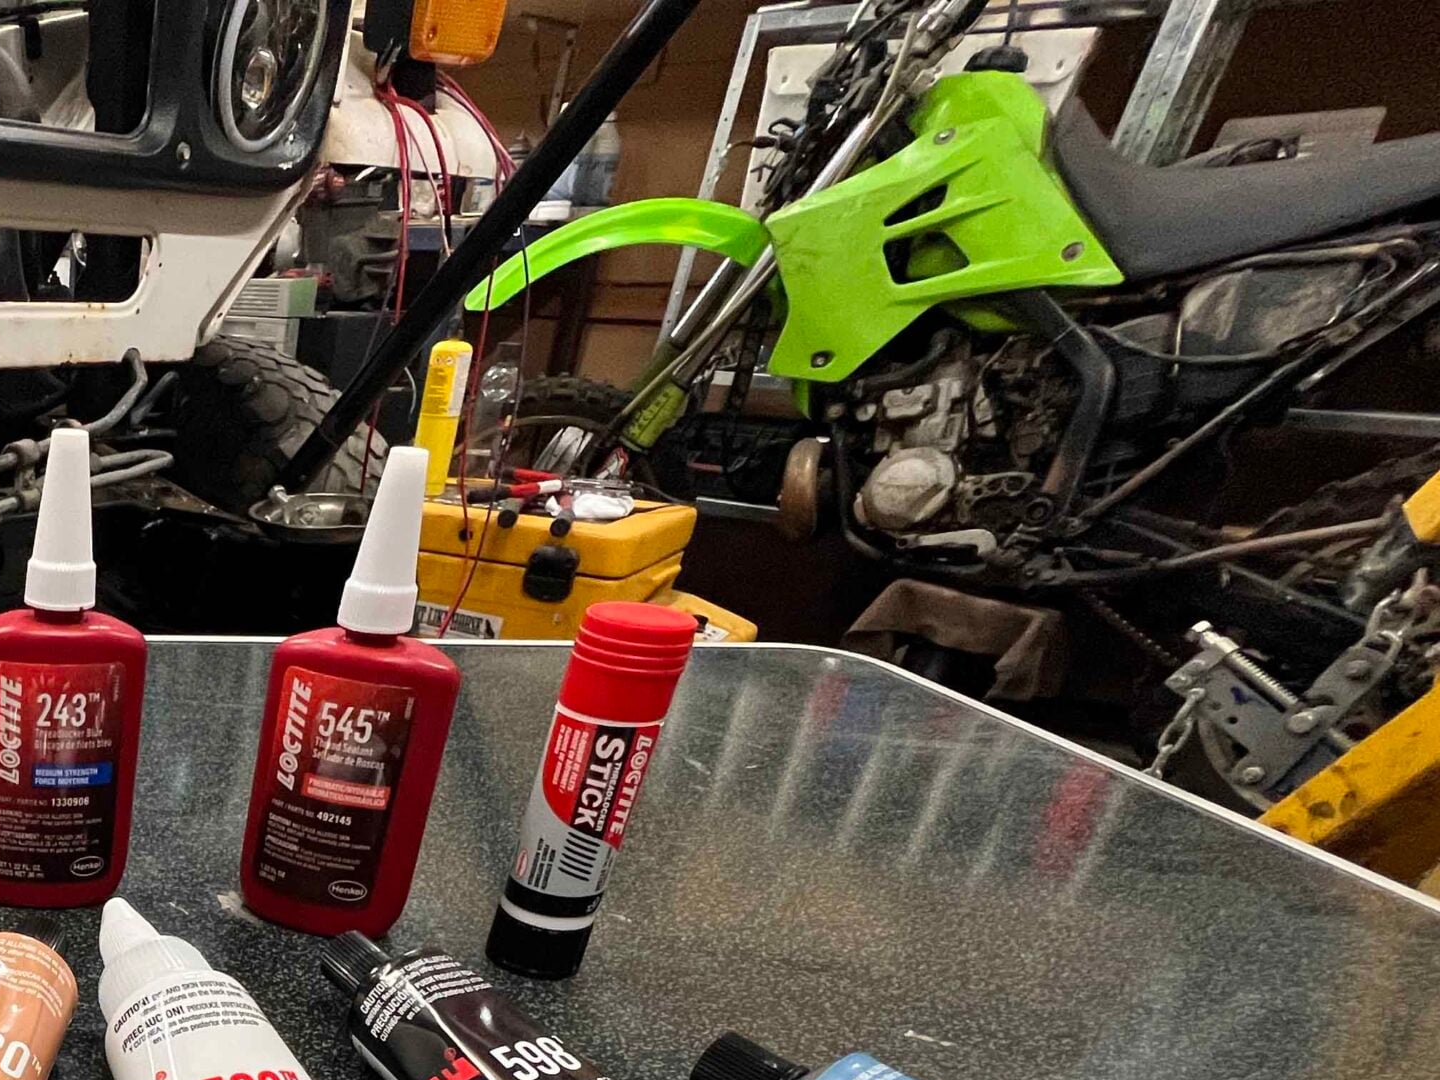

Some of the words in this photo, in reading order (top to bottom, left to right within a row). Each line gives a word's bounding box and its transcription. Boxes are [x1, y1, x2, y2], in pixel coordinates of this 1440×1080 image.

[277, 677, 312, 791] LOCTITE
[356, 757, 385, 770] Roscas
[573, 734, 626, 829] STICK
[596, 761, 623, 832] THREADLOCKER
[610, 735, 653, 835] LOCTITE
[317, 811, 352, 826] 492145
[332, 885, 364, 895] Henkel
